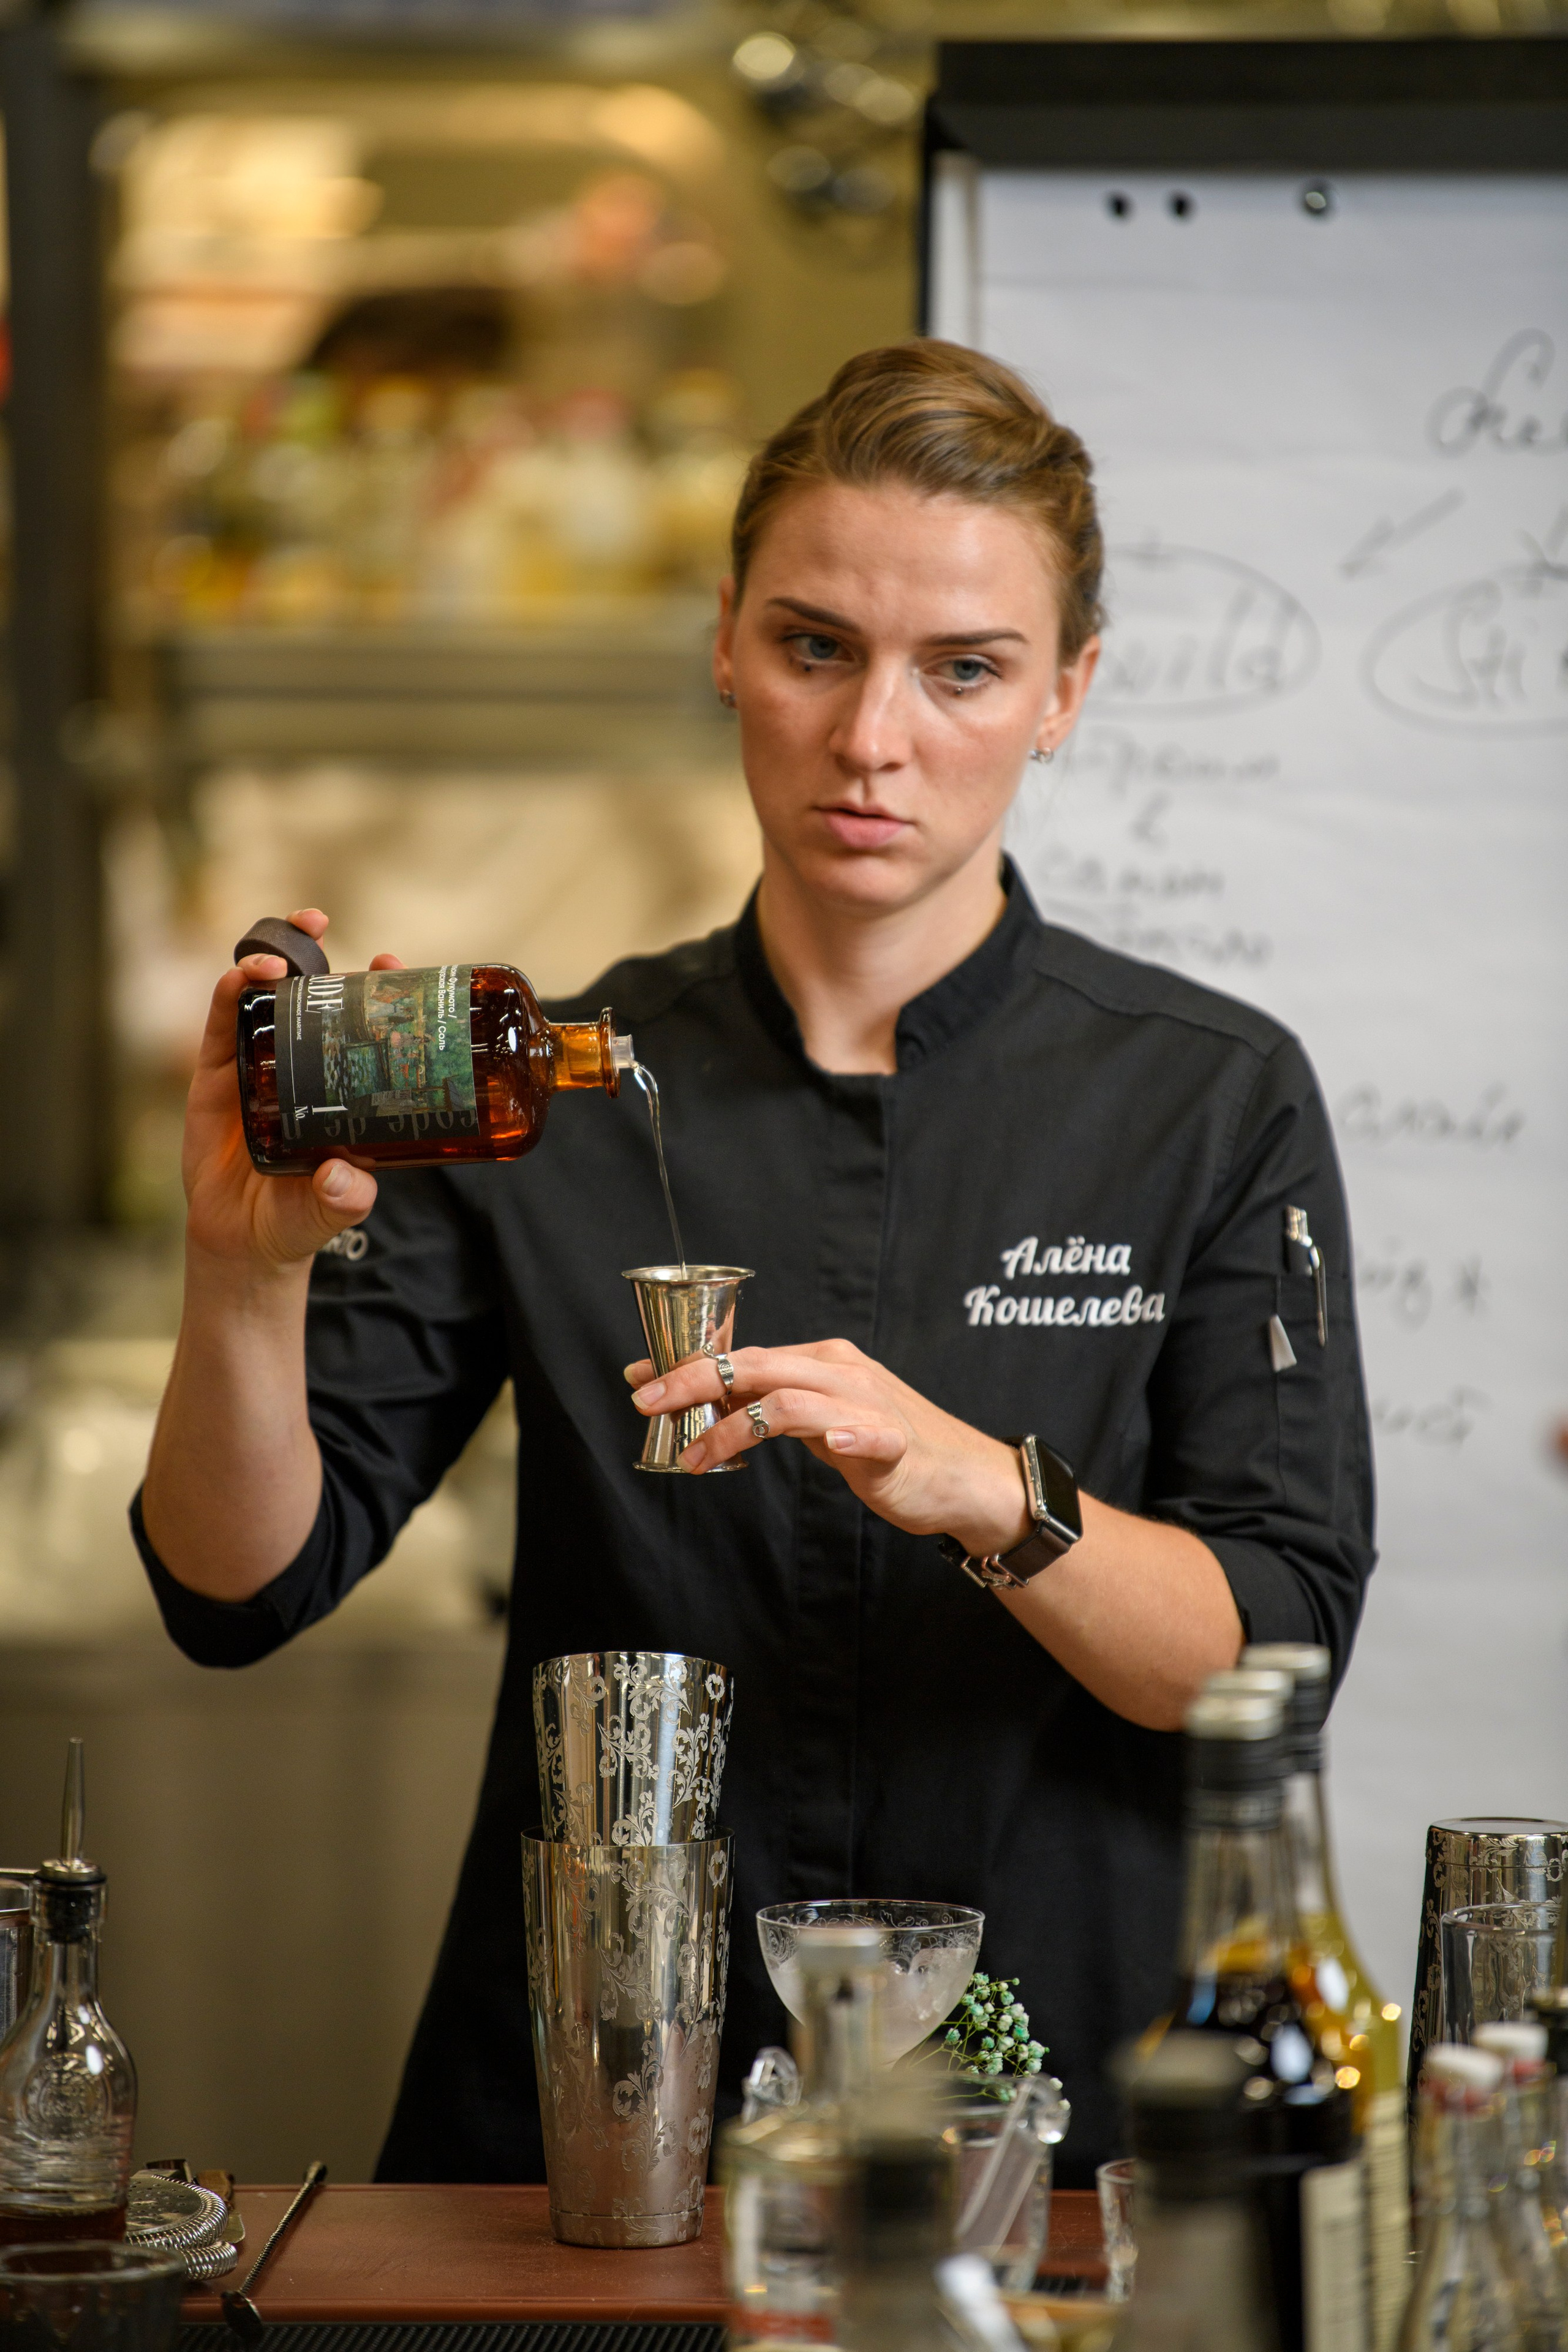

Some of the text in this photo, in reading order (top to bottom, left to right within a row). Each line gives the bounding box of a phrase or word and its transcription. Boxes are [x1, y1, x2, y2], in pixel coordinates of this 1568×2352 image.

[437, 989, 446, 1019] Ваниль
[447, 977, 458, 1012] Фукумото
[438, 1025, 447, 1050] Соль
[1000, 1235, 1131, 1281] Алёна
[963, 1284, 1166, 1327] Кошелева
